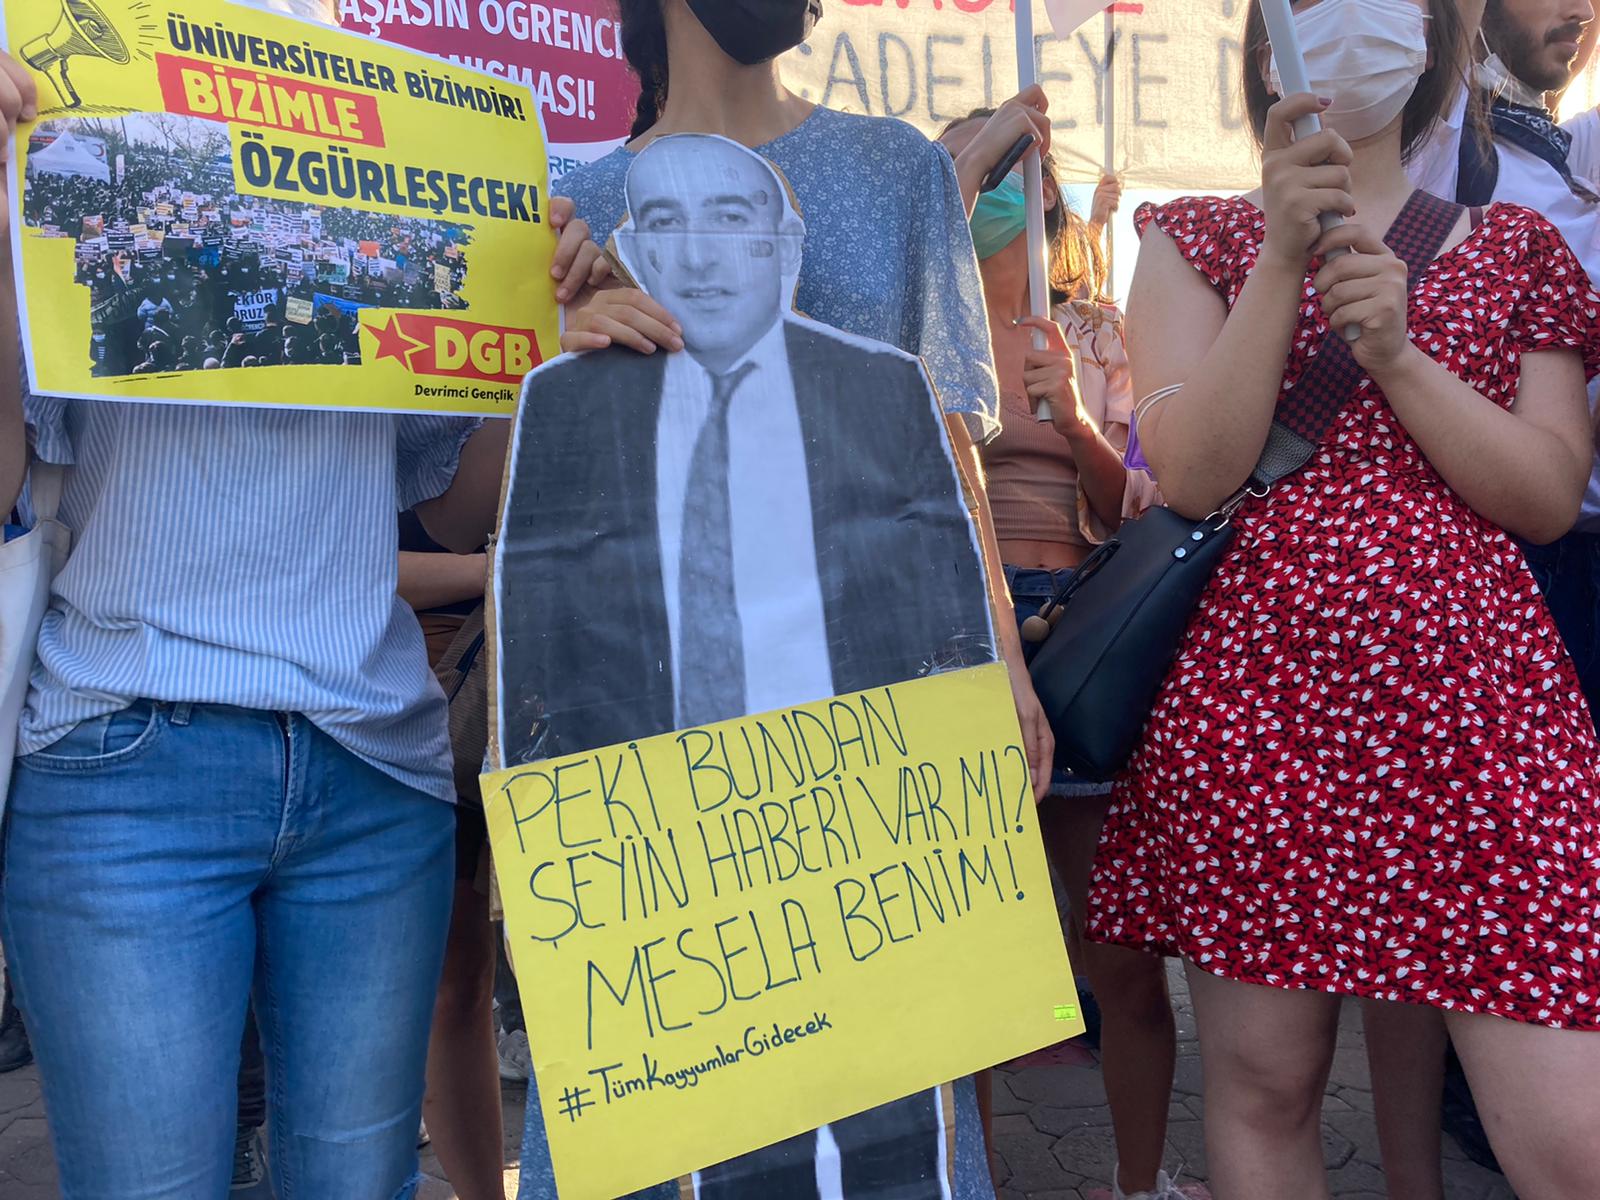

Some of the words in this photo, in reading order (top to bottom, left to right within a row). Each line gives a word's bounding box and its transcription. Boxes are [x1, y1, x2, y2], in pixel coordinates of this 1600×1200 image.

[167, 12, 398, 94] ÜNİVERSİTELER
[404, 69, 526, 121] BİZİMDİR!
[181, 66, 364, 140] BİZİMLE
[240, 130, 541, 223] ÖZGÜRLEŞECEK!
[414, 384, 469, 398] Devrimci
[471, 387, 514, 403] Gençlik
[434, 325, 532, 376] DGB
[501, 742, 661, 854] PEKİ
[677, 687, 908, 813] BUNDAN
[529, 828, 690, 949] ŞEYİN
[697, 774, 861, 897] HABERİ
[856, 761, 959, 846] VAR
[960, 745, 1028, 838] MI?
[588, 898, 821, 1051] MESELA
[834, 840, 1024, 962] BENİM!
[558, 1011, 833, 1122] #TümKayyumlarGidecek
